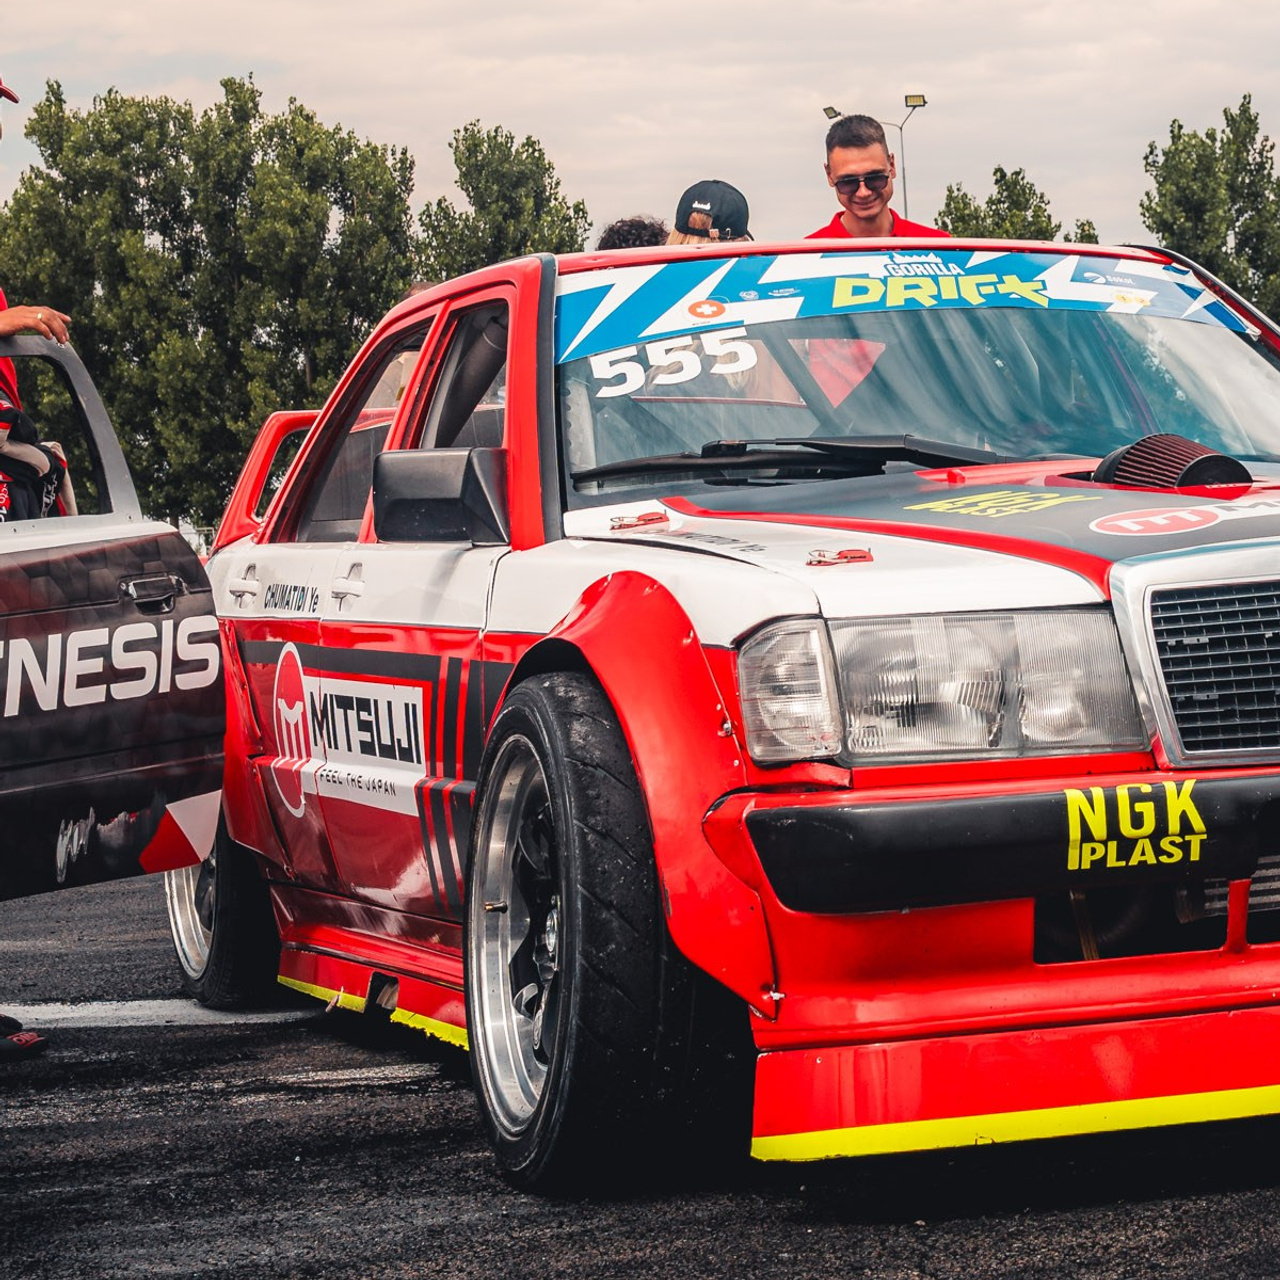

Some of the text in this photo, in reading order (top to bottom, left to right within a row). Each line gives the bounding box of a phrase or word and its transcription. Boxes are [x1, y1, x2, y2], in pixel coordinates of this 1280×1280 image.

[832, 274, 1049, 308] DRIFT
[887, 262, 966, 277] GORILLA
[589, 327, 758, 398] 555
[0, 615, 220, 717] NESIS
[310, 691, 422, 765] MITSUJI
[320, 769, 397, 797] FEEL THE JAPAN
[1064, 779, 1207, 844] NGK
